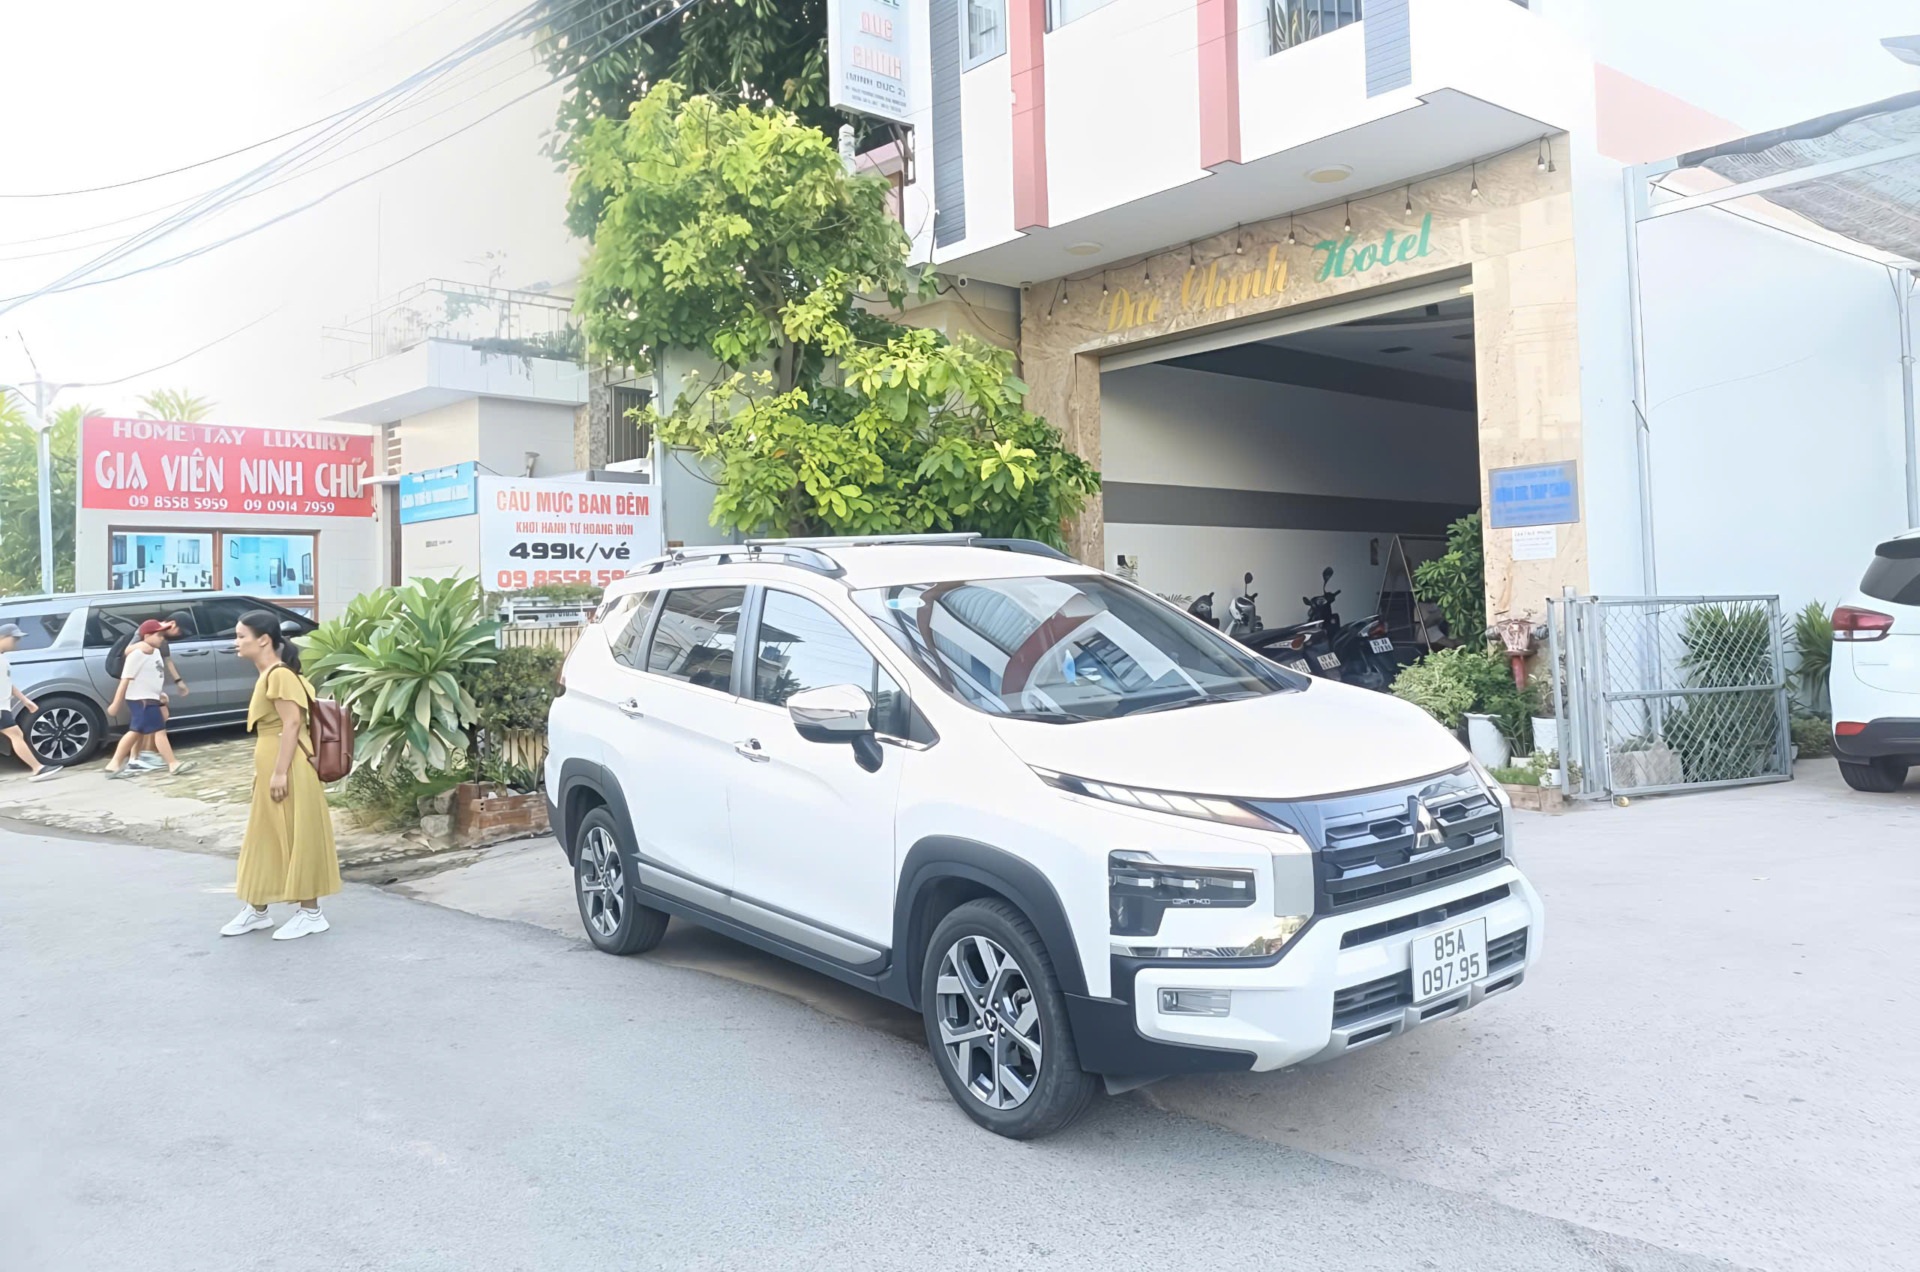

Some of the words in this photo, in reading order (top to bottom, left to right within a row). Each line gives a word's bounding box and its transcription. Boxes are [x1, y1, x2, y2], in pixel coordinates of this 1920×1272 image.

[1313, 212, 1433, 284] Hotel
[113, 420, 190, 442] HOME
[264, 430, 350, 451] LUXURY
[95, 450, 149, 490] GIA
[161, 447, 224, 493] VIÊN
[240, 457, 303, 496] NINH
[128, 495, 149, 508] 09
[154, 495, 189, 509] 8558
[194, 497, 228, 511] 5959
[243, 499, 262, 512] 09
[267, 500, 298, 513] 0914
[303, 501, 335, 514] 7959
[578, 493, 611, 515] BAN
[509, 541, 630, 563] 499k/vé
[497, 570, 528, 588] 09
[533, 570, 592, 588] 8558
[1434, 928, 1466, 961] 85A
[1422, 952, 1480, 996] 097.95
